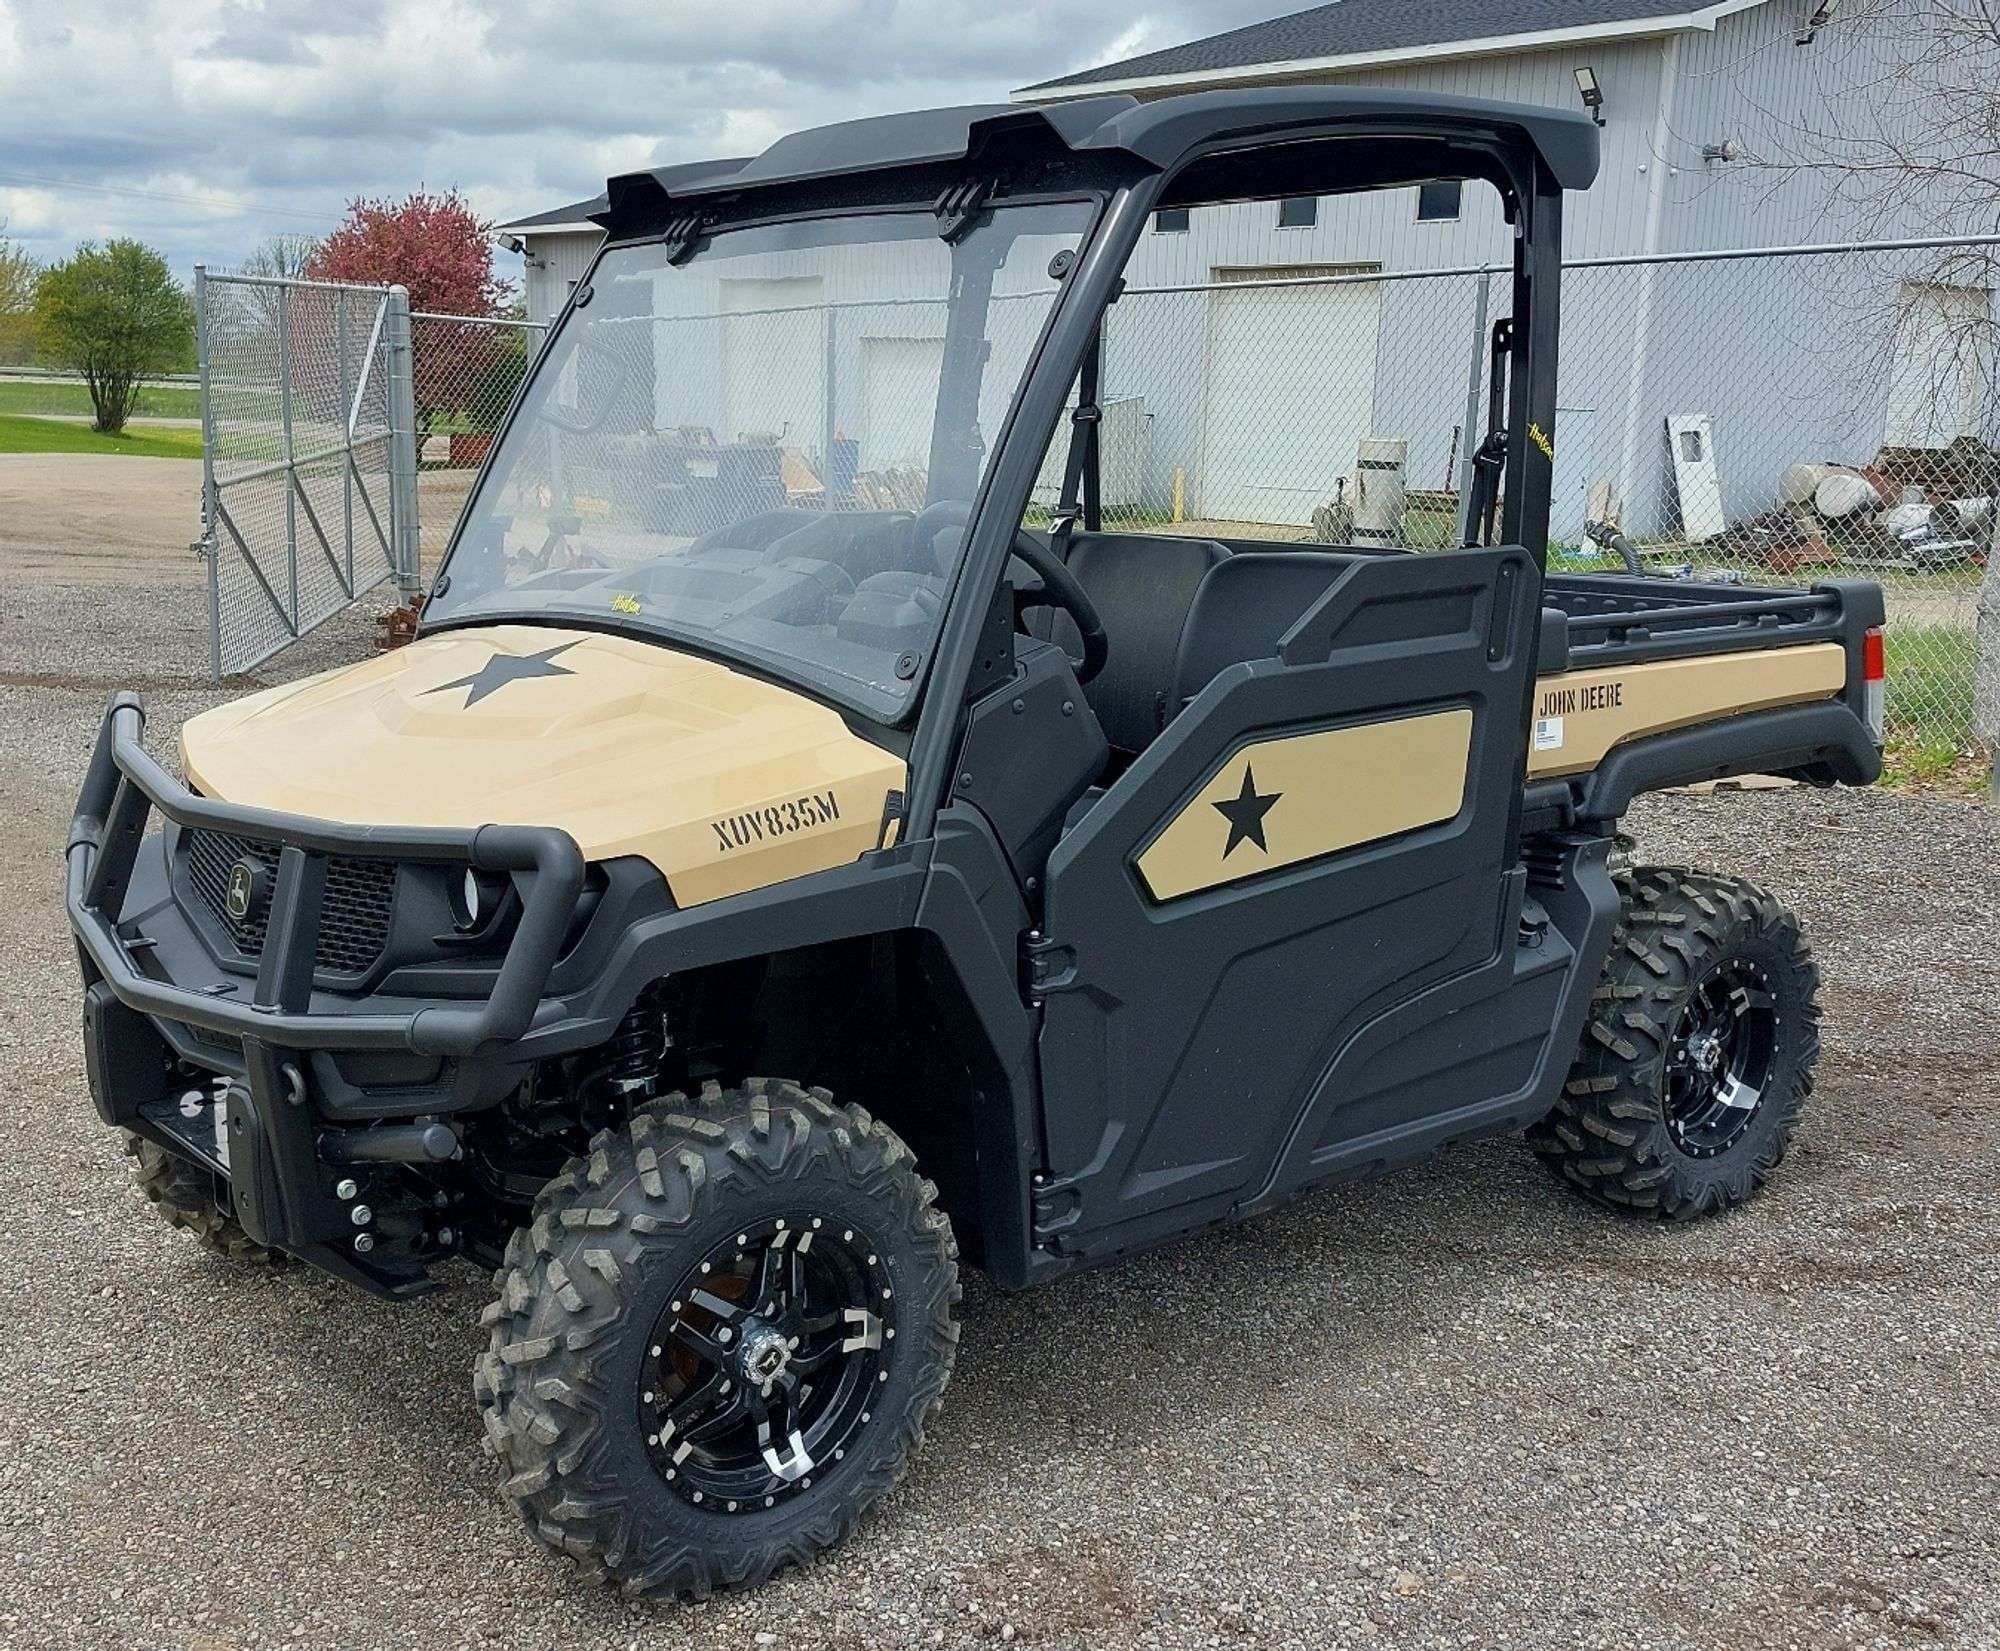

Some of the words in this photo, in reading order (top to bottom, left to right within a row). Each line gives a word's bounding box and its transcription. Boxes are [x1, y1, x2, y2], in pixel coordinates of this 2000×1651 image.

[1540, 688, 1576, 717] JOHN
[1581, 683, 1623, 712] DEERE
[711, 790, 840, 851] XUV835M
